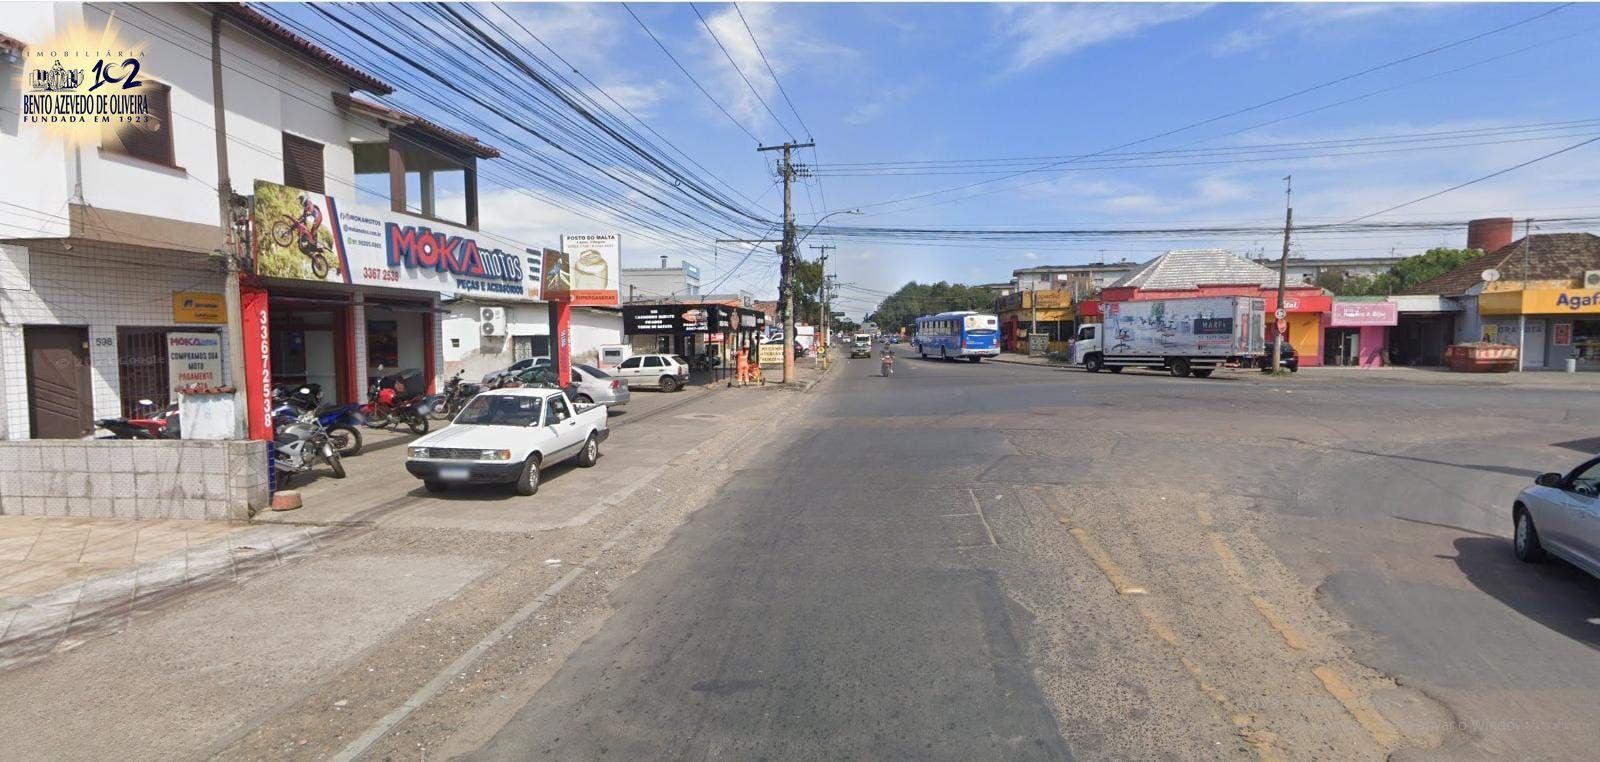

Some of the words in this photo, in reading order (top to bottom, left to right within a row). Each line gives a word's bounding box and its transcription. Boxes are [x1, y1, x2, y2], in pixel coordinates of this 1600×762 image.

[363, 267, 380, 280] 3367
[382, 269, 399, 282] 2538
[456, 278, 480, 292] PEÇAS
[481, 281, 486, 291] E
[486, 281, 524, 295] ACESSÓRIOS
[1556, 292, 1600, 310] Agaf
[171, 351, 207, 360] COMPRAMOS
[208, 351, 219, 359] SUA
[188, 362, 204, 370] MOTO
